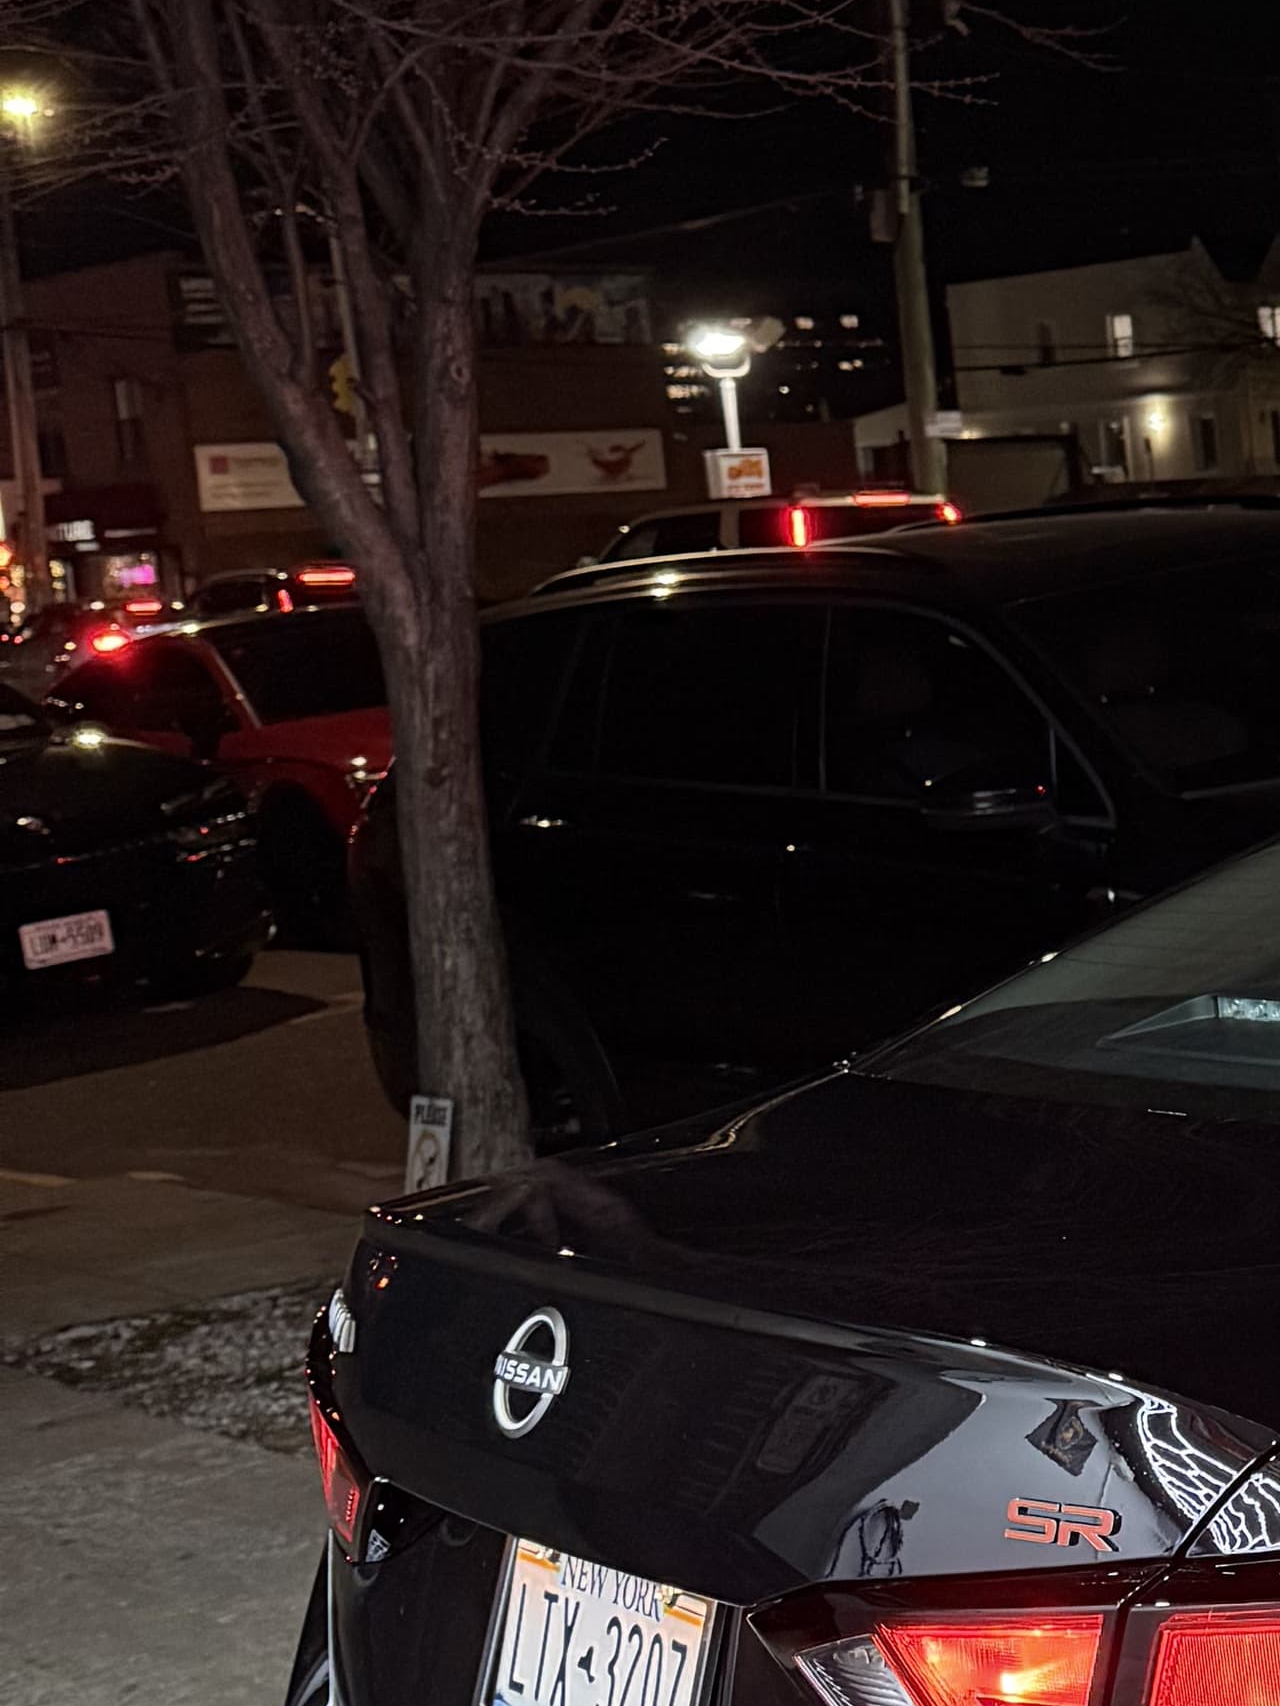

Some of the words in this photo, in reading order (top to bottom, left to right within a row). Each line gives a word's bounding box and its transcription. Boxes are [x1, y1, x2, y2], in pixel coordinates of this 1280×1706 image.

[494, 1355, 564, 1391] NISSAN
[1004, 1498, 1119, 1552] SR
[560, 1556, 609, 1598] NEW
[612, 1571, 661, 1622] YORK
